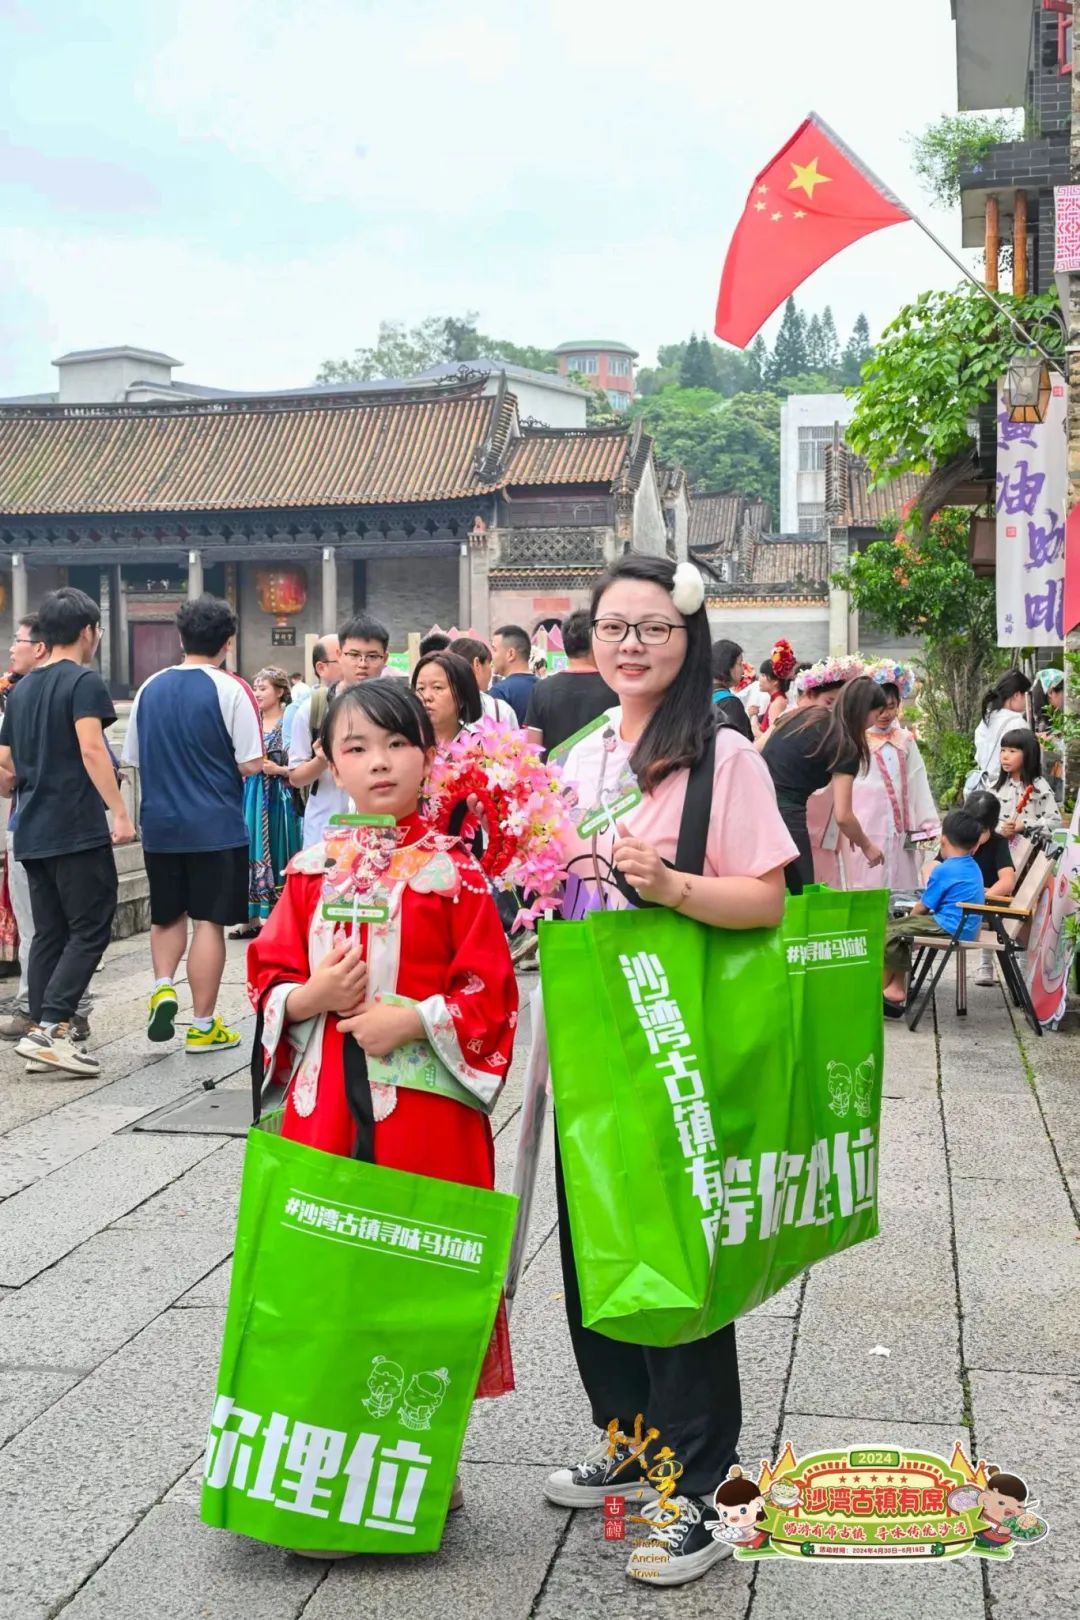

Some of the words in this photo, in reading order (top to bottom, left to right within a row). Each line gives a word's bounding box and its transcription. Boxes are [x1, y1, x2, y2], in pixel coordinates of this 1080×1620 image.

[284, 1197, 484, 1265] #沙湾古镇寻味马拉松
